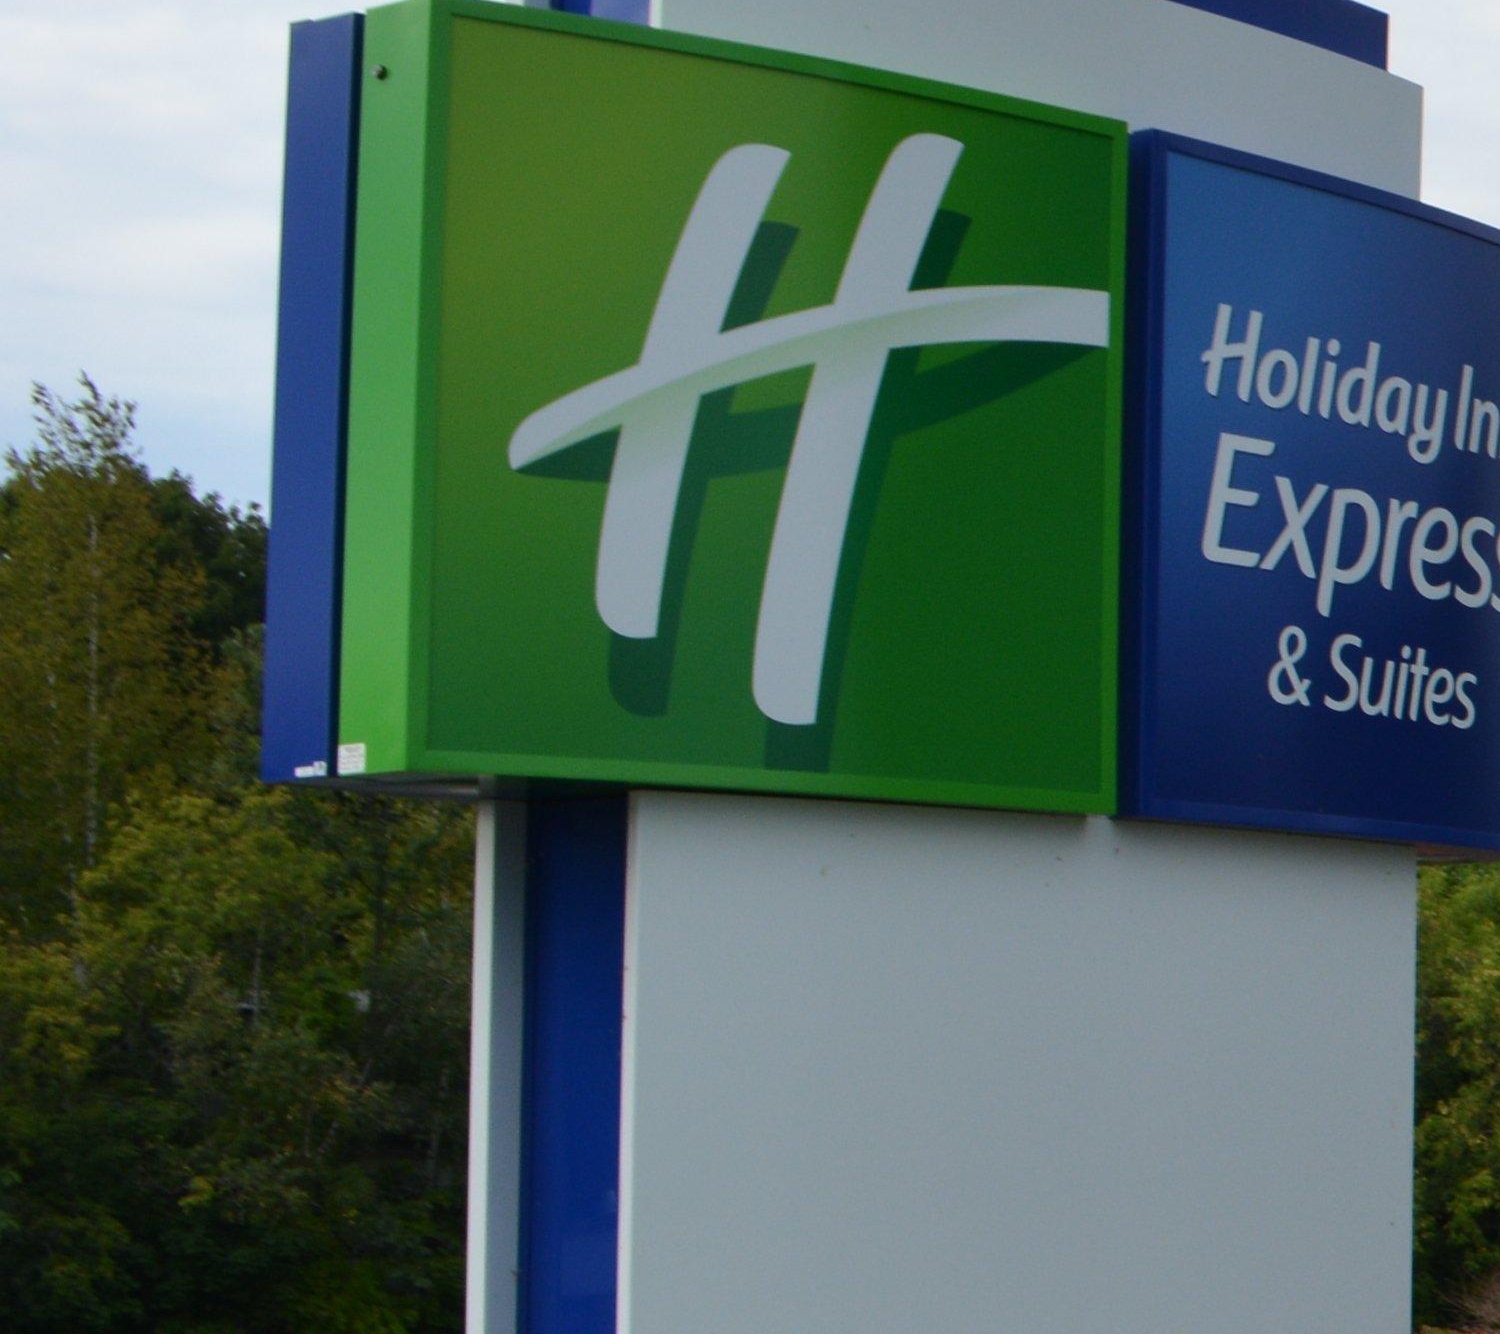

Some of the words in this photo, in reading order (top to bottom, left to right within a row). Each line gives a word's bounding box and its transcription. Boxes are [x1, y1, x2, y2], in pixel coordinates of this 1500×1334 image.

[1201, 302, 1449, 464] Holiday
[1267, 625, 1311, 707] &
[1323, 633, 1478, 730] Suites
